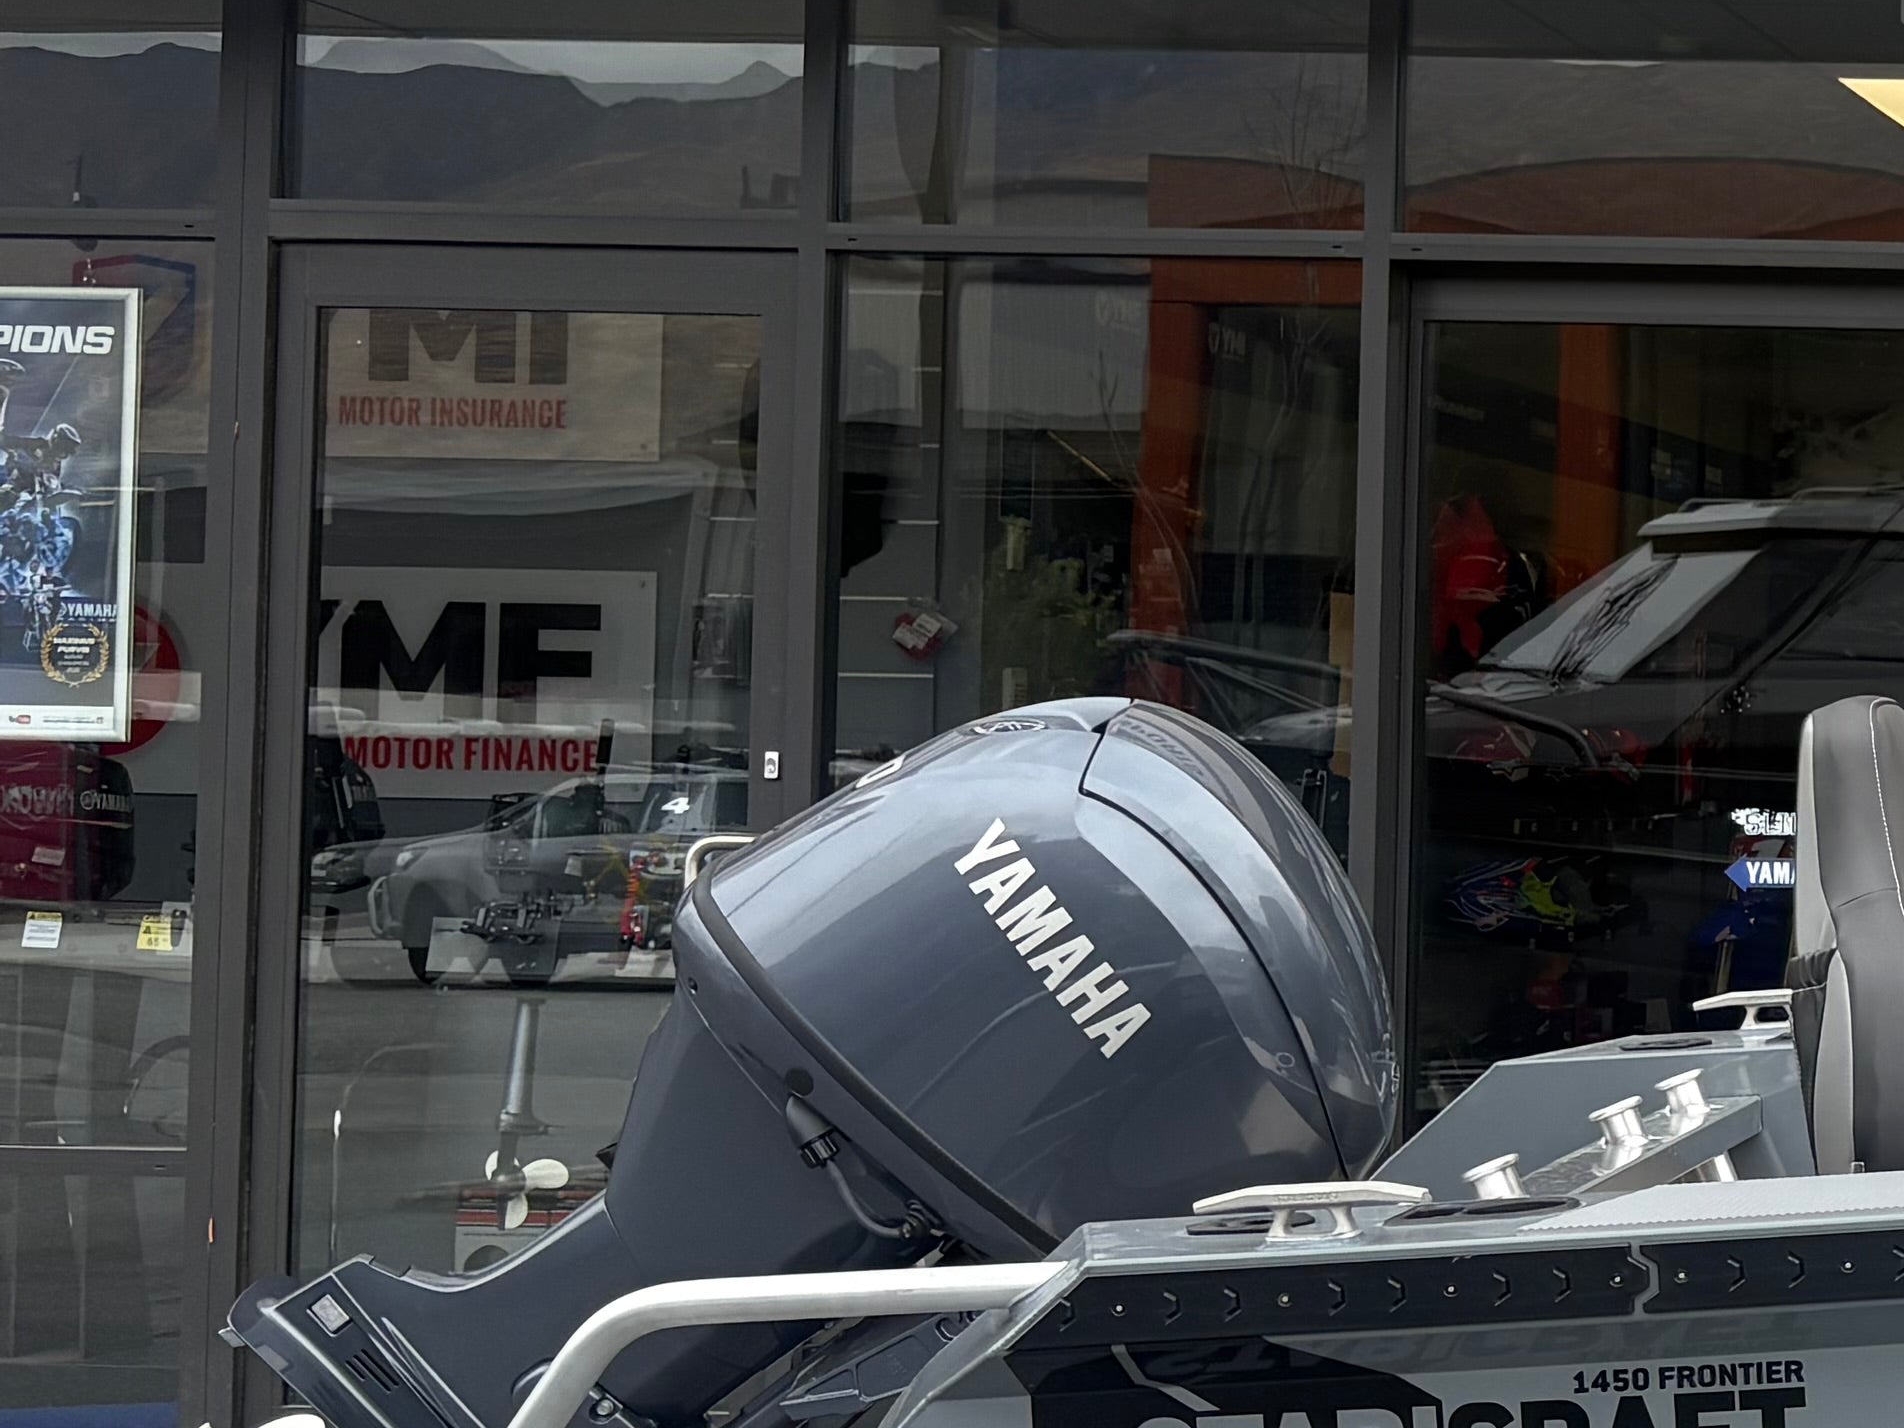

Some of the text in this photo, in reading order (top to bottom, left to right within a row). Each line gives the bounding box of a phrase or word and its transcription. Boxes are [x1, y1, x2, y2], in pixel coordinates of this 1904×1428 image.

[338, 395, 567, 429] MOTOR INSURANCE
[345, 736, 597, 772] MOTOR FINANCE
[1746, 861, 1796, 884] YAM
[954, 818, 1152, 1060] YAMAHA
[1573, 1359, 1805, 1395] 1450 FRONTIER
